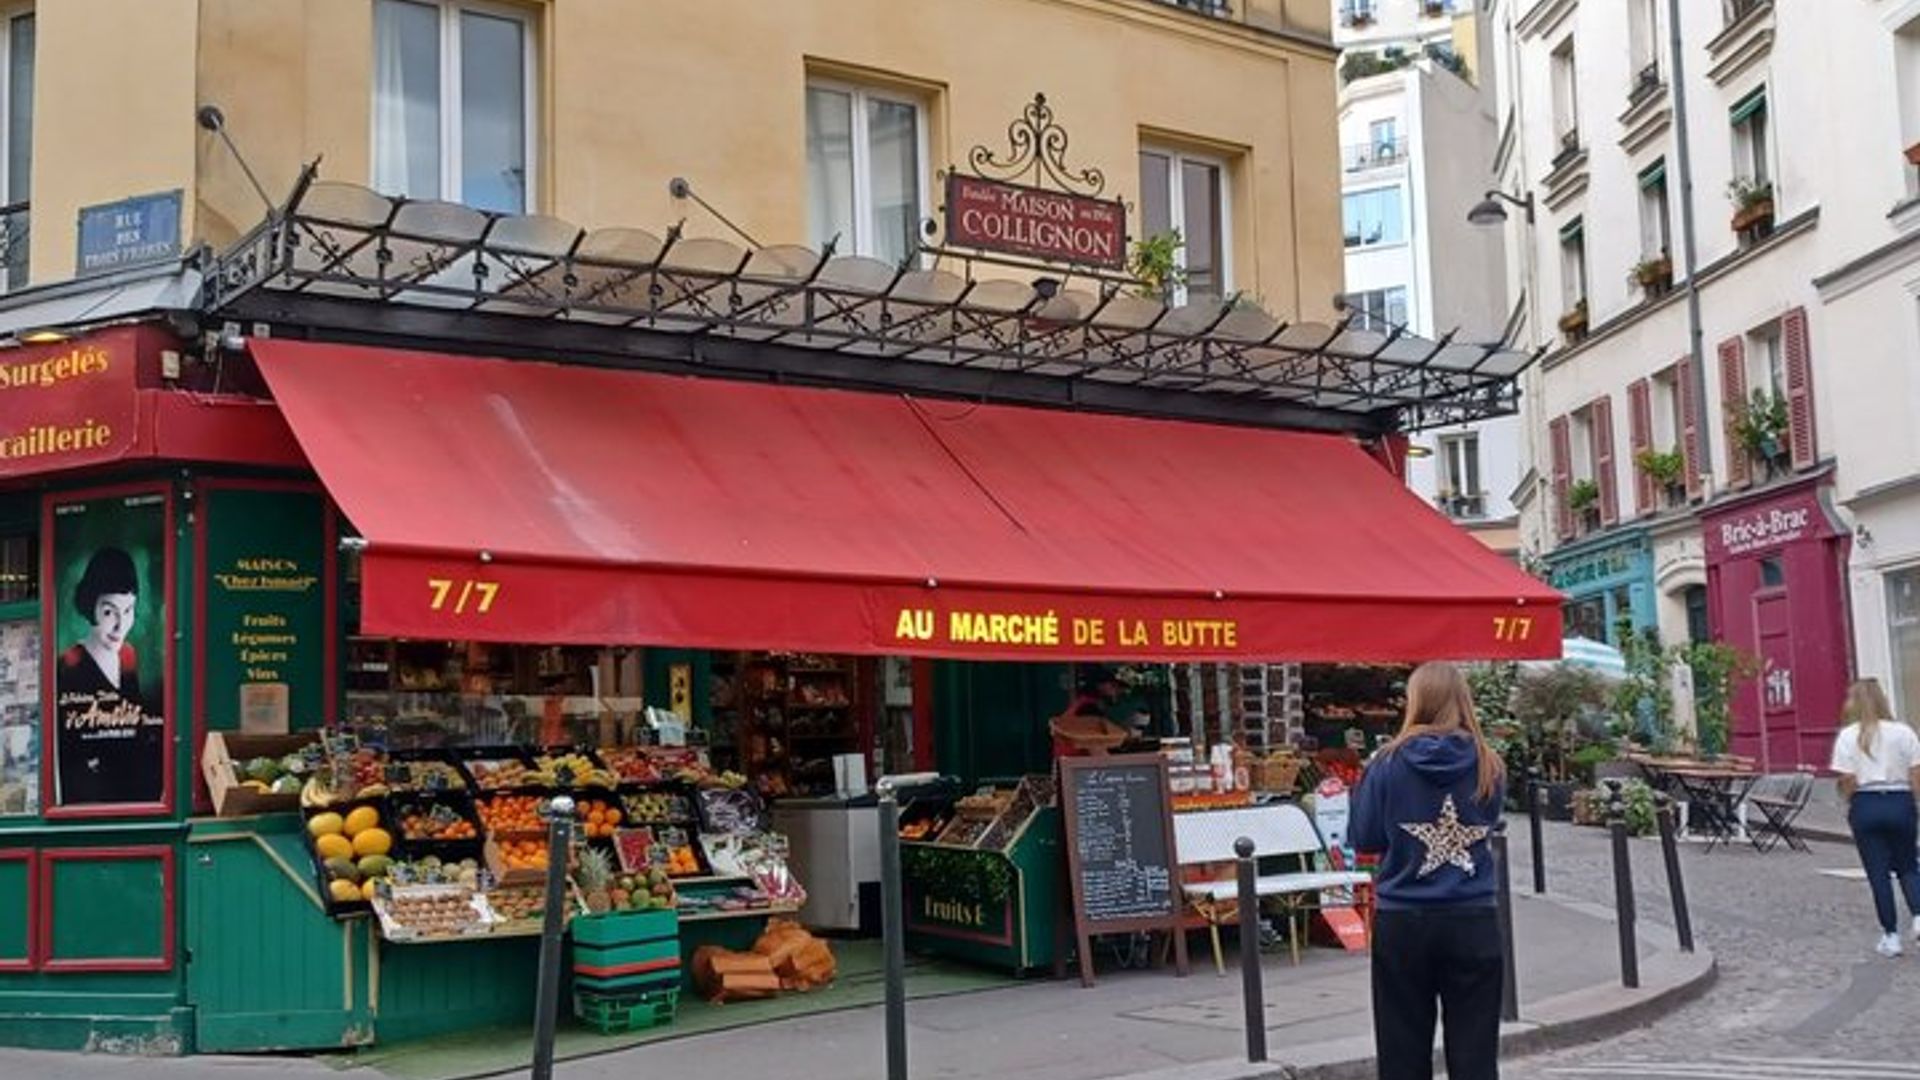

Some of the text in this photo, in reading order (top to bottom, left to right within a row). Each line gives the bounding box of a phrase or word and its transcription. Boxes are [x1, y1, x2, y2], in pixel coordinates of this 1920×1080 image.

[1001, 190, 1074, 222] MAISON
[962, 209, 1111, 256] COLLIGNON
[0, 346, 108, 389] Surgelés
[1721, 508, 1808, 547] Bric-à-Brac
[237, 559, 298, 571] MAISON
[428, 579, 499, 614] 7/7
[244, 614, 287, 626] Fruits
[896, 609, 1237, 647] AU MARCHÉ DE LA BUTTE
[1493, 617, 1532, 642] 7/7
[925, 895, 973, 925] Fruits
